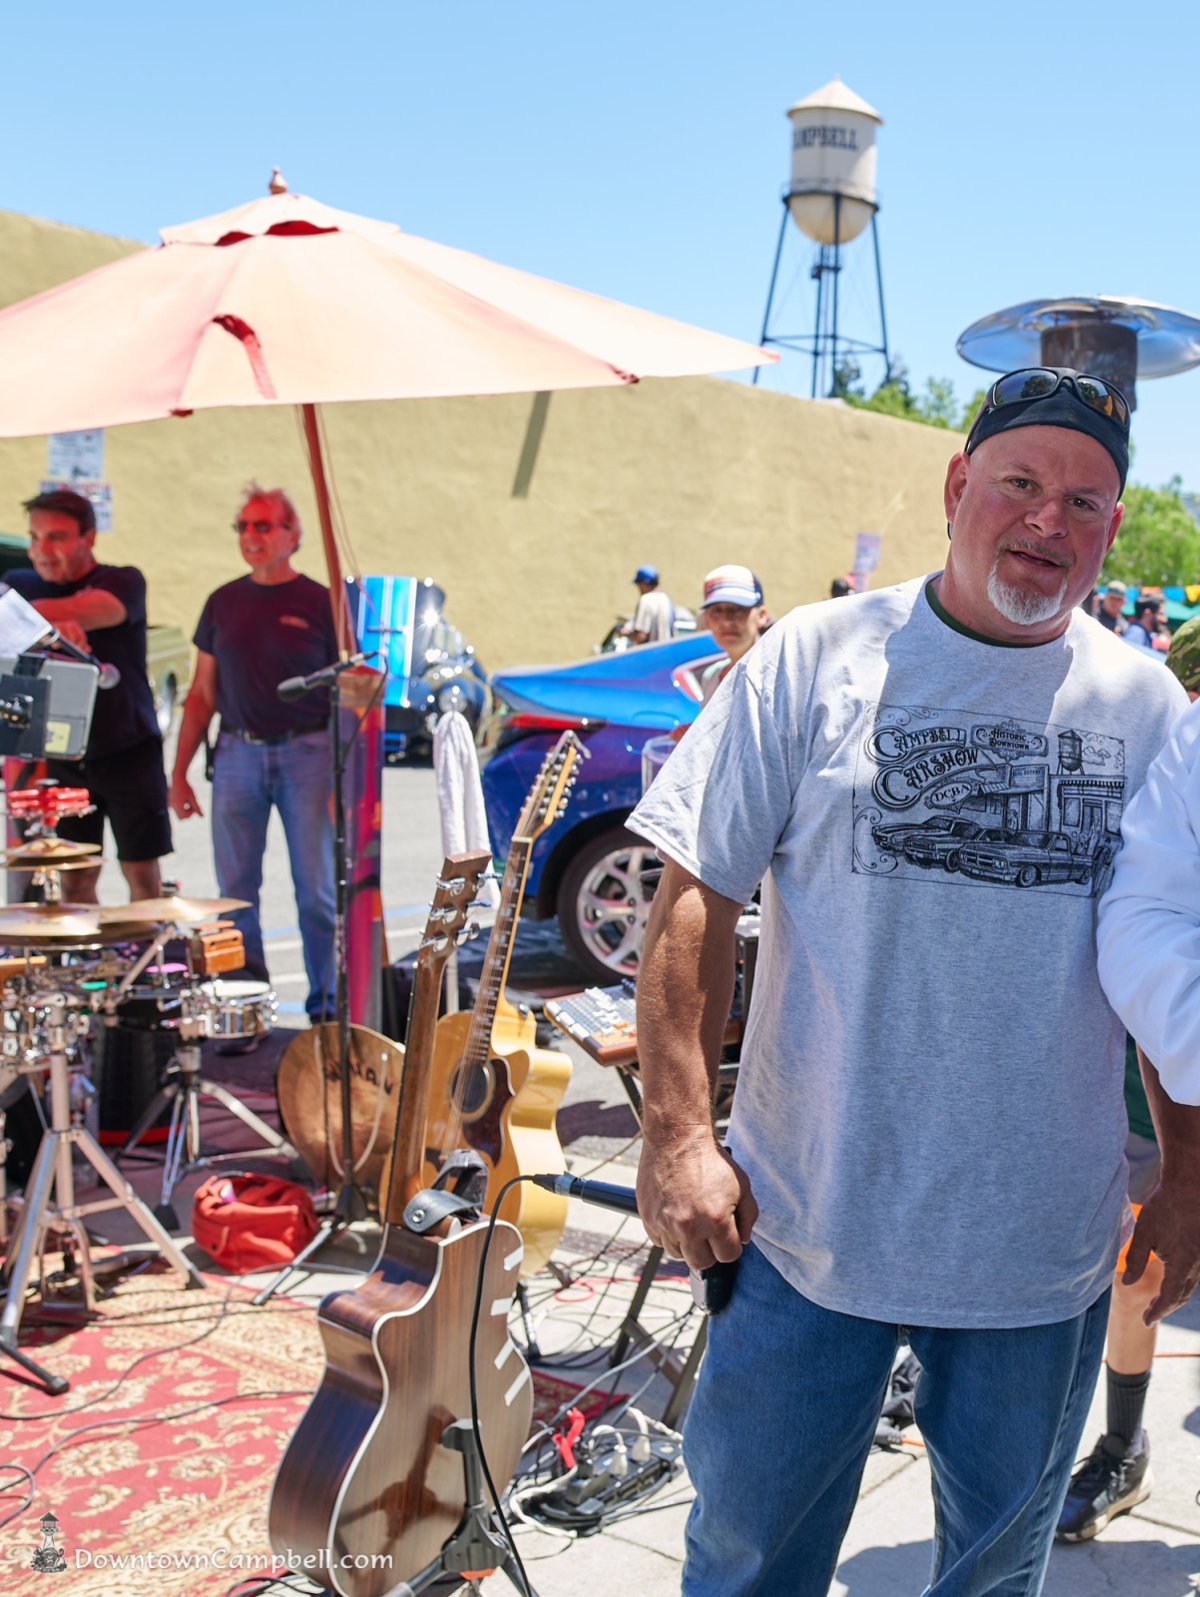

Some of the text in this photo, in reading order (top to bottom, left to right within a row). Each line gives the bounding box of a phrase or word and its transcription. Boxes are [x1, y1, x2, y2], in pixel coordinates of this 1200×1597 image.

[991, 728, 1027, 742] HISTORIC
[989, 738, 1030, 750] DOWNTOWN
[934, 784, 970, 802] DCBA
